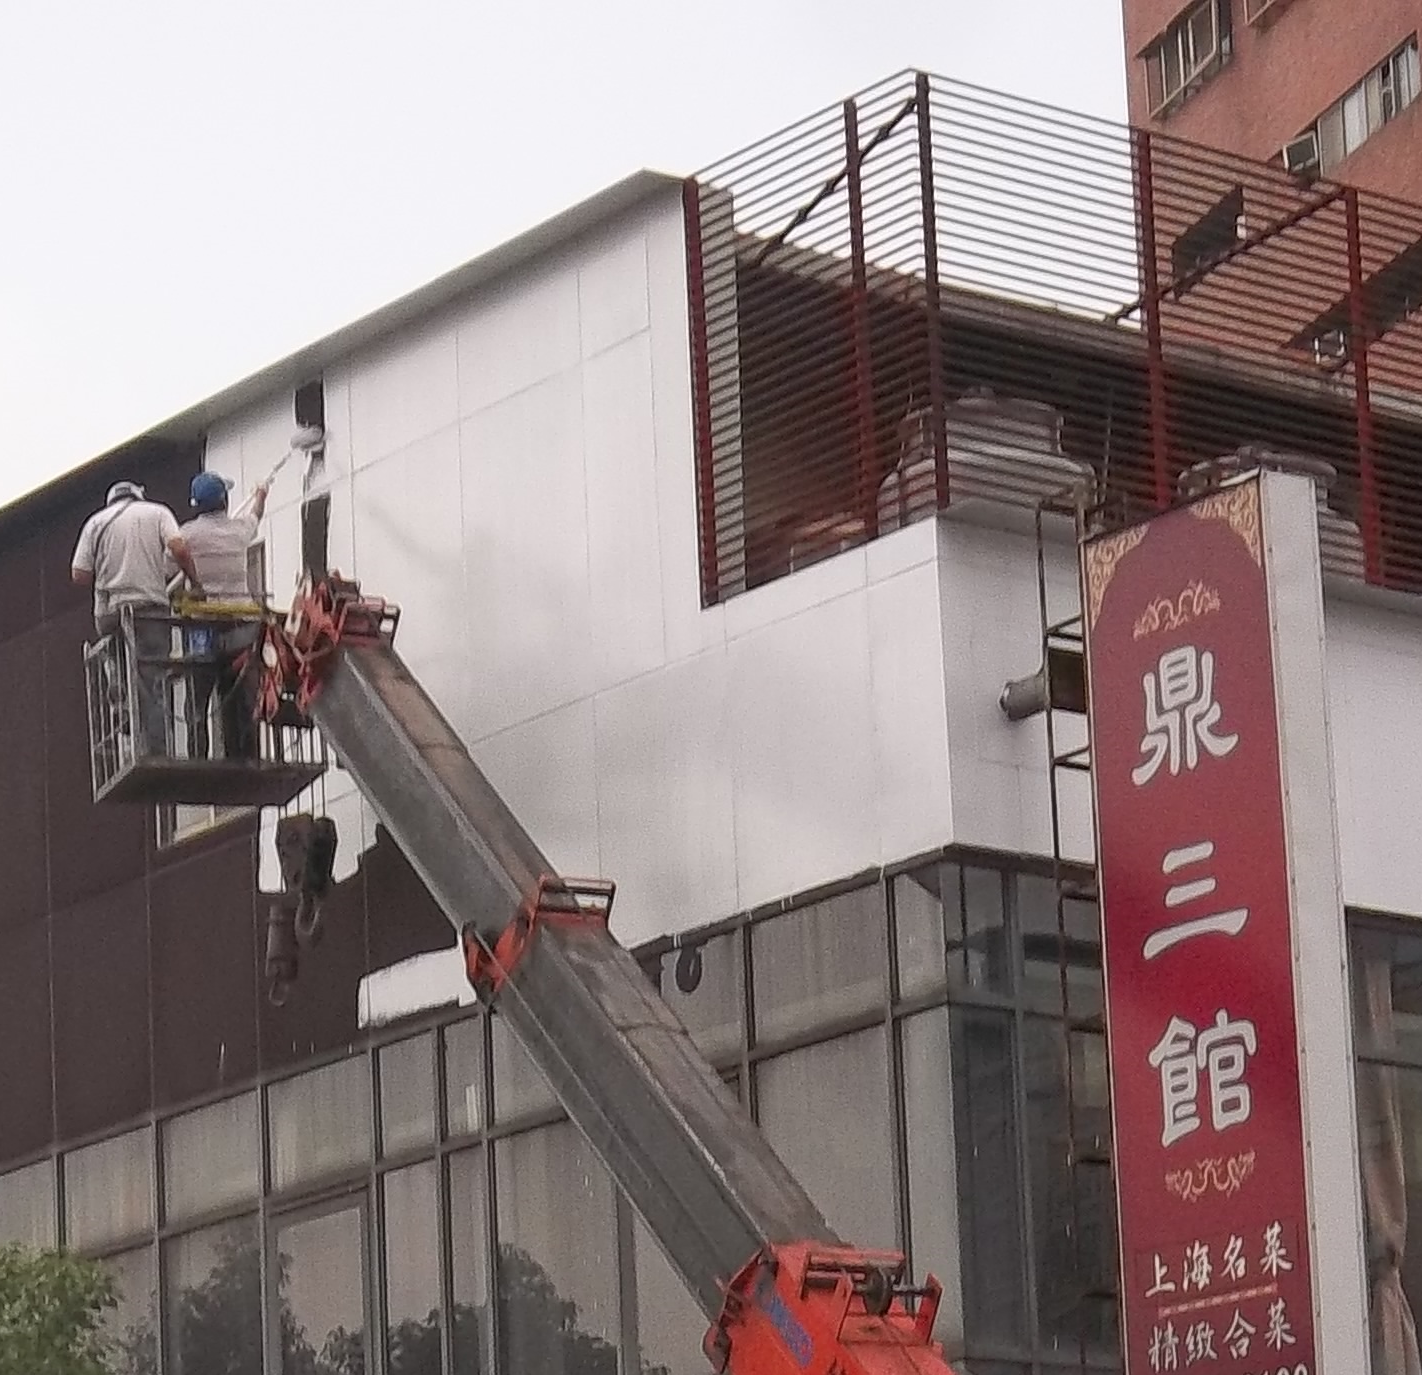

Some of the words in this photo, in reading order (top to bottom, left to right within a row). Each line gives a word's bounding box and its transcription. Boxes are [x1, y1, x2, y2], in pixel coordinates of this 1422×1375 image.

[1131, 645, 1258, 1148] 鼎三館
[1145, 1220, 1293, 1298] 上海名菜
[1148, 1297, 1297, 1374] 精緻合菜
